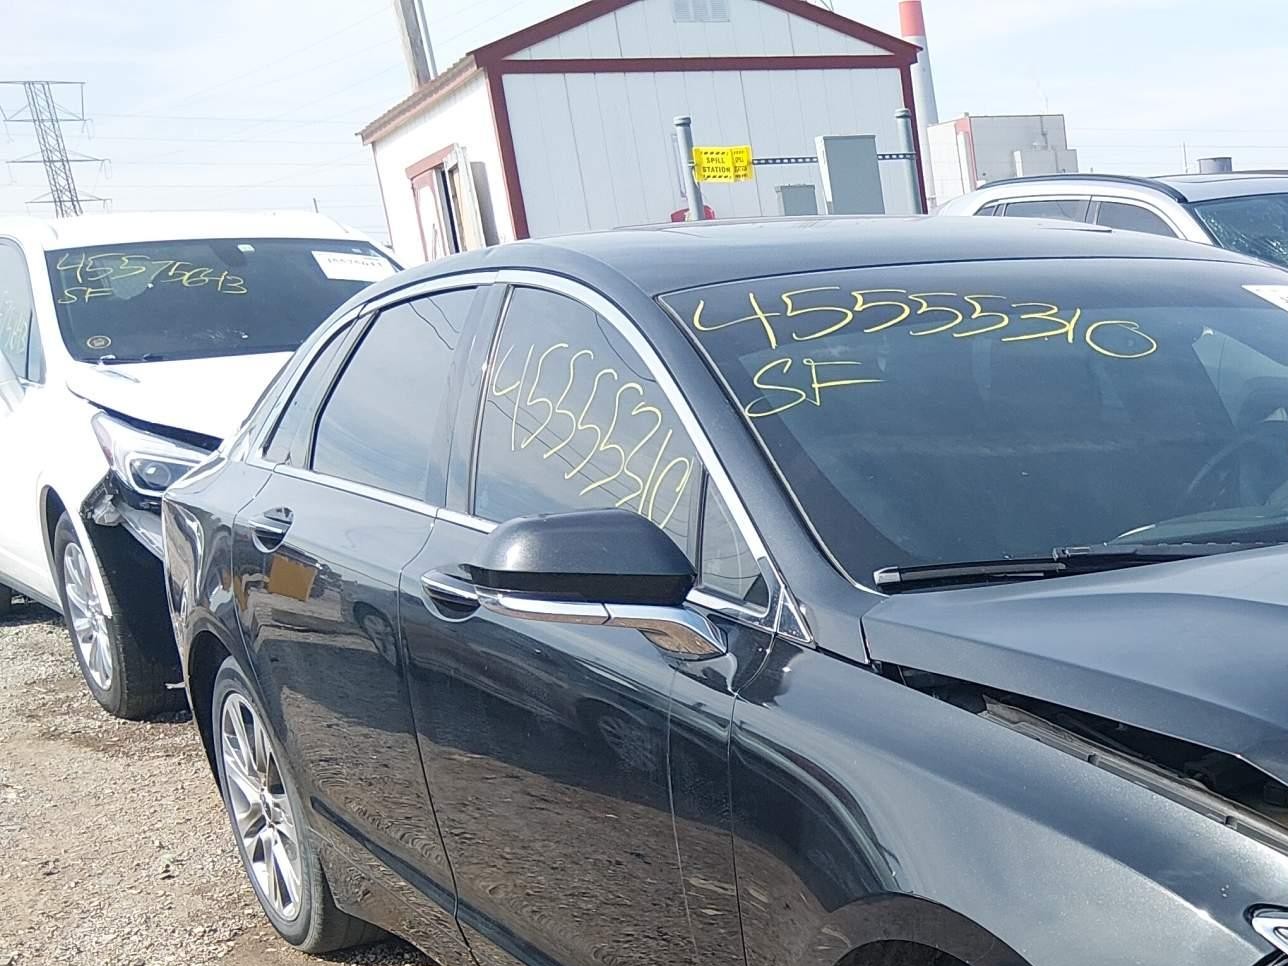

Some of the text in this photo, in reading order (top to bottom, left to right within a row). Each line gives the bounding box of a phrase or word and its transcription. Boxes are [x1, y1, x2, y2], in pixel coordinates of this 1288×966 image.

[58, 286, 114, 304] SF
[693, 286, 1159, 360] 45555310
[744, 358, 886, 417] SF
